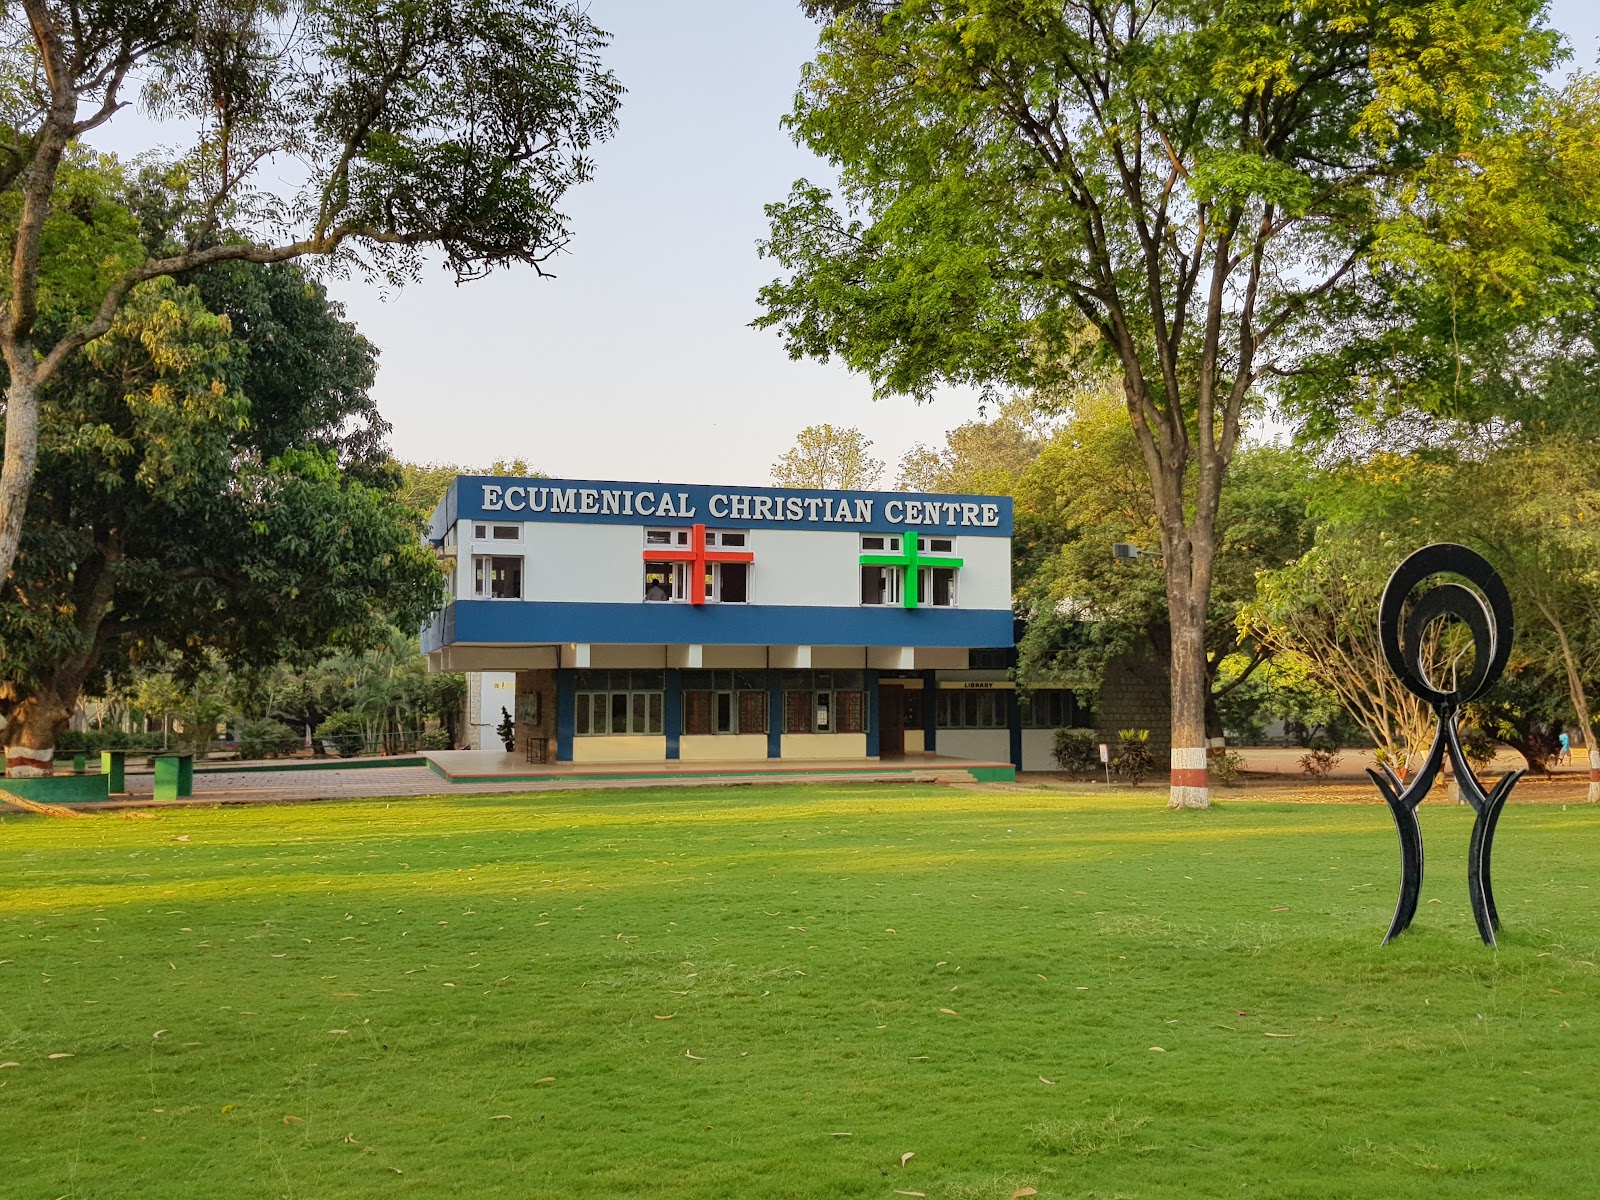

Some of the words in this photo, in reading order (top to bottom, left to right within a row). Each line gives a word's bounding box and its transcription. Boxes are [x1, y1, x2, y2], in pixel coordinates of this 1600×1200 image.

[481, 485, 696, 518] ECUMENICAL
[708, 494, 874, 523] CHRISTIAN
[884, 500, 1000, 528] CENTRE
